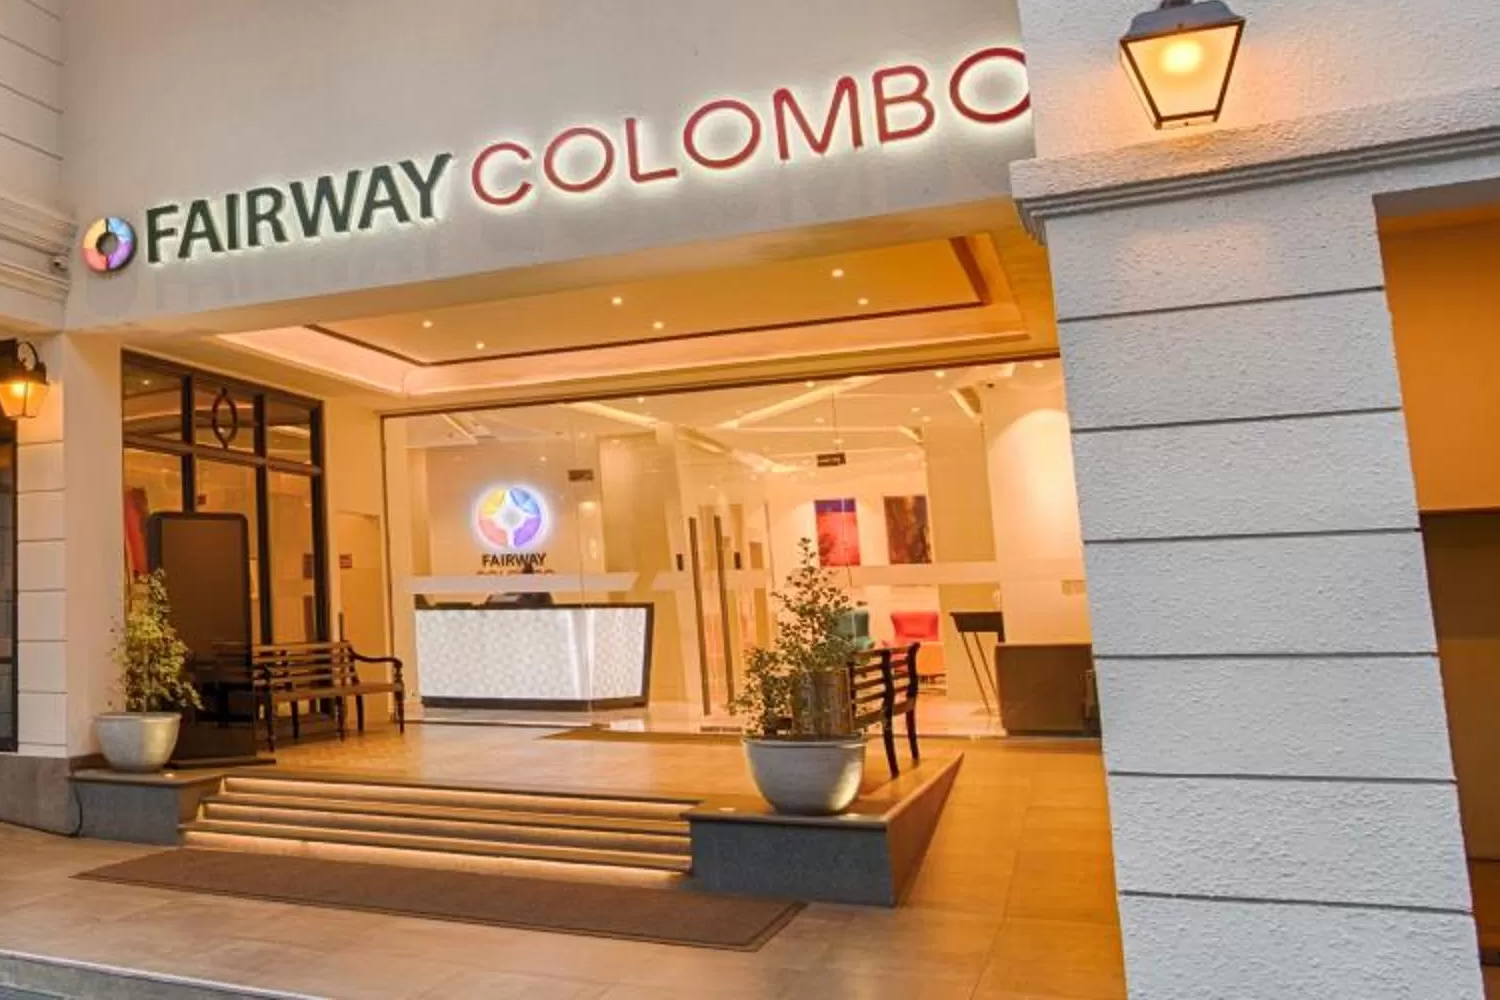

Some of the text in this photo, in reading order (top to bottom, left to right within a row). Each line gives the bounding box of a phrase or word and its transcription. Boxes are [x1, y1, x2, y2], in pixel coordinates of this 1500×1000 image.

[146, 48, 1031, 263] FAIRWAY COLOMBO
[481, 552, 547, 568] FAIRWAY
